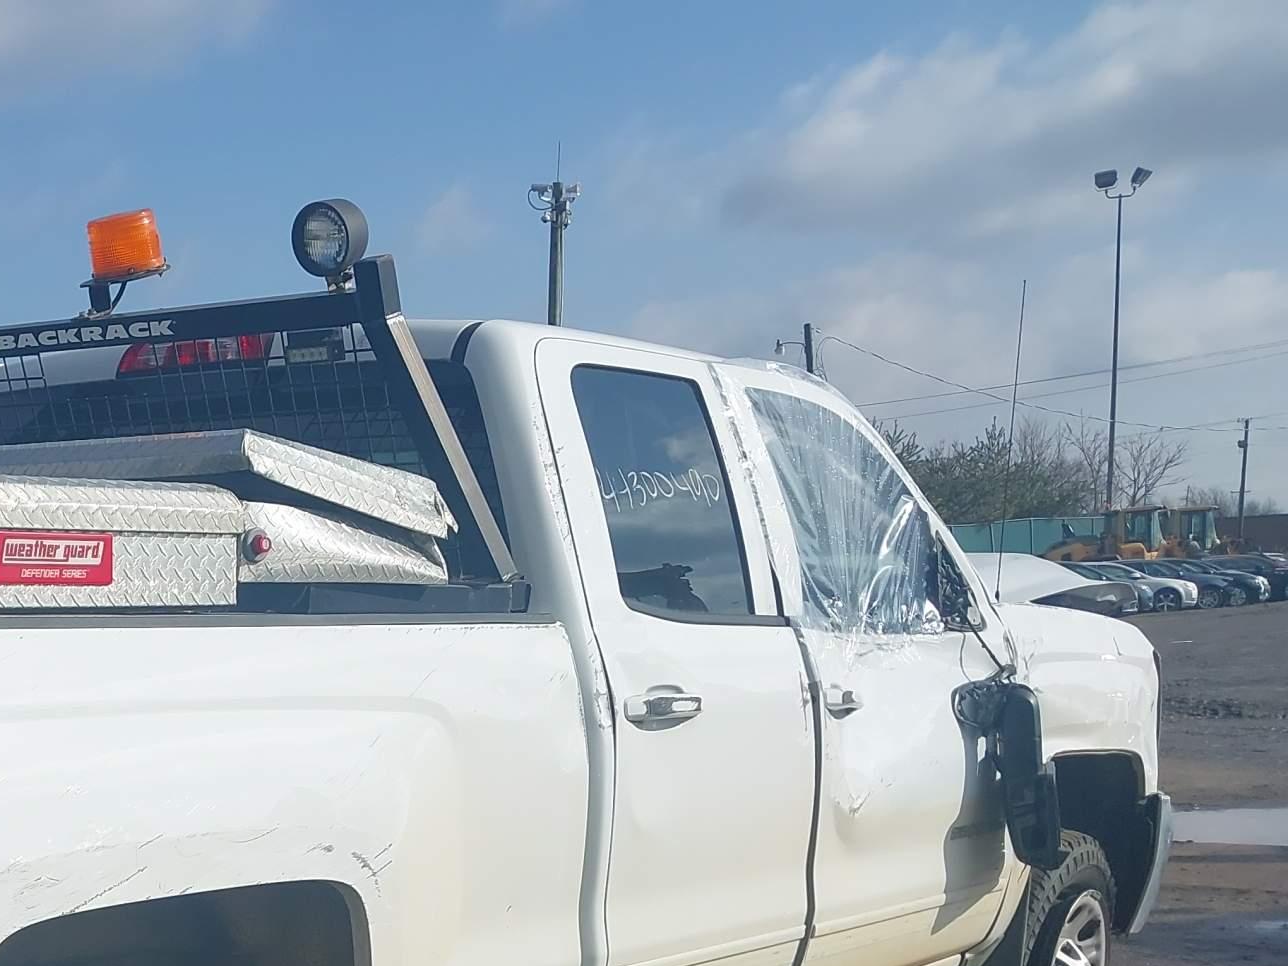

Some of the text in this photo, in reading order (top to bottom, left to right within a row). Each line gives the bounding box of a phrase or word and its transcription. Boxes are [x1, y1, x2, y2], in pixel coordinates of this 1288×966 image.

[595, 468, 721, 513] 44300490
[4, 541, 101, 562] weather guard
[20, 568, 87, 578] DEFENDER SERIES
